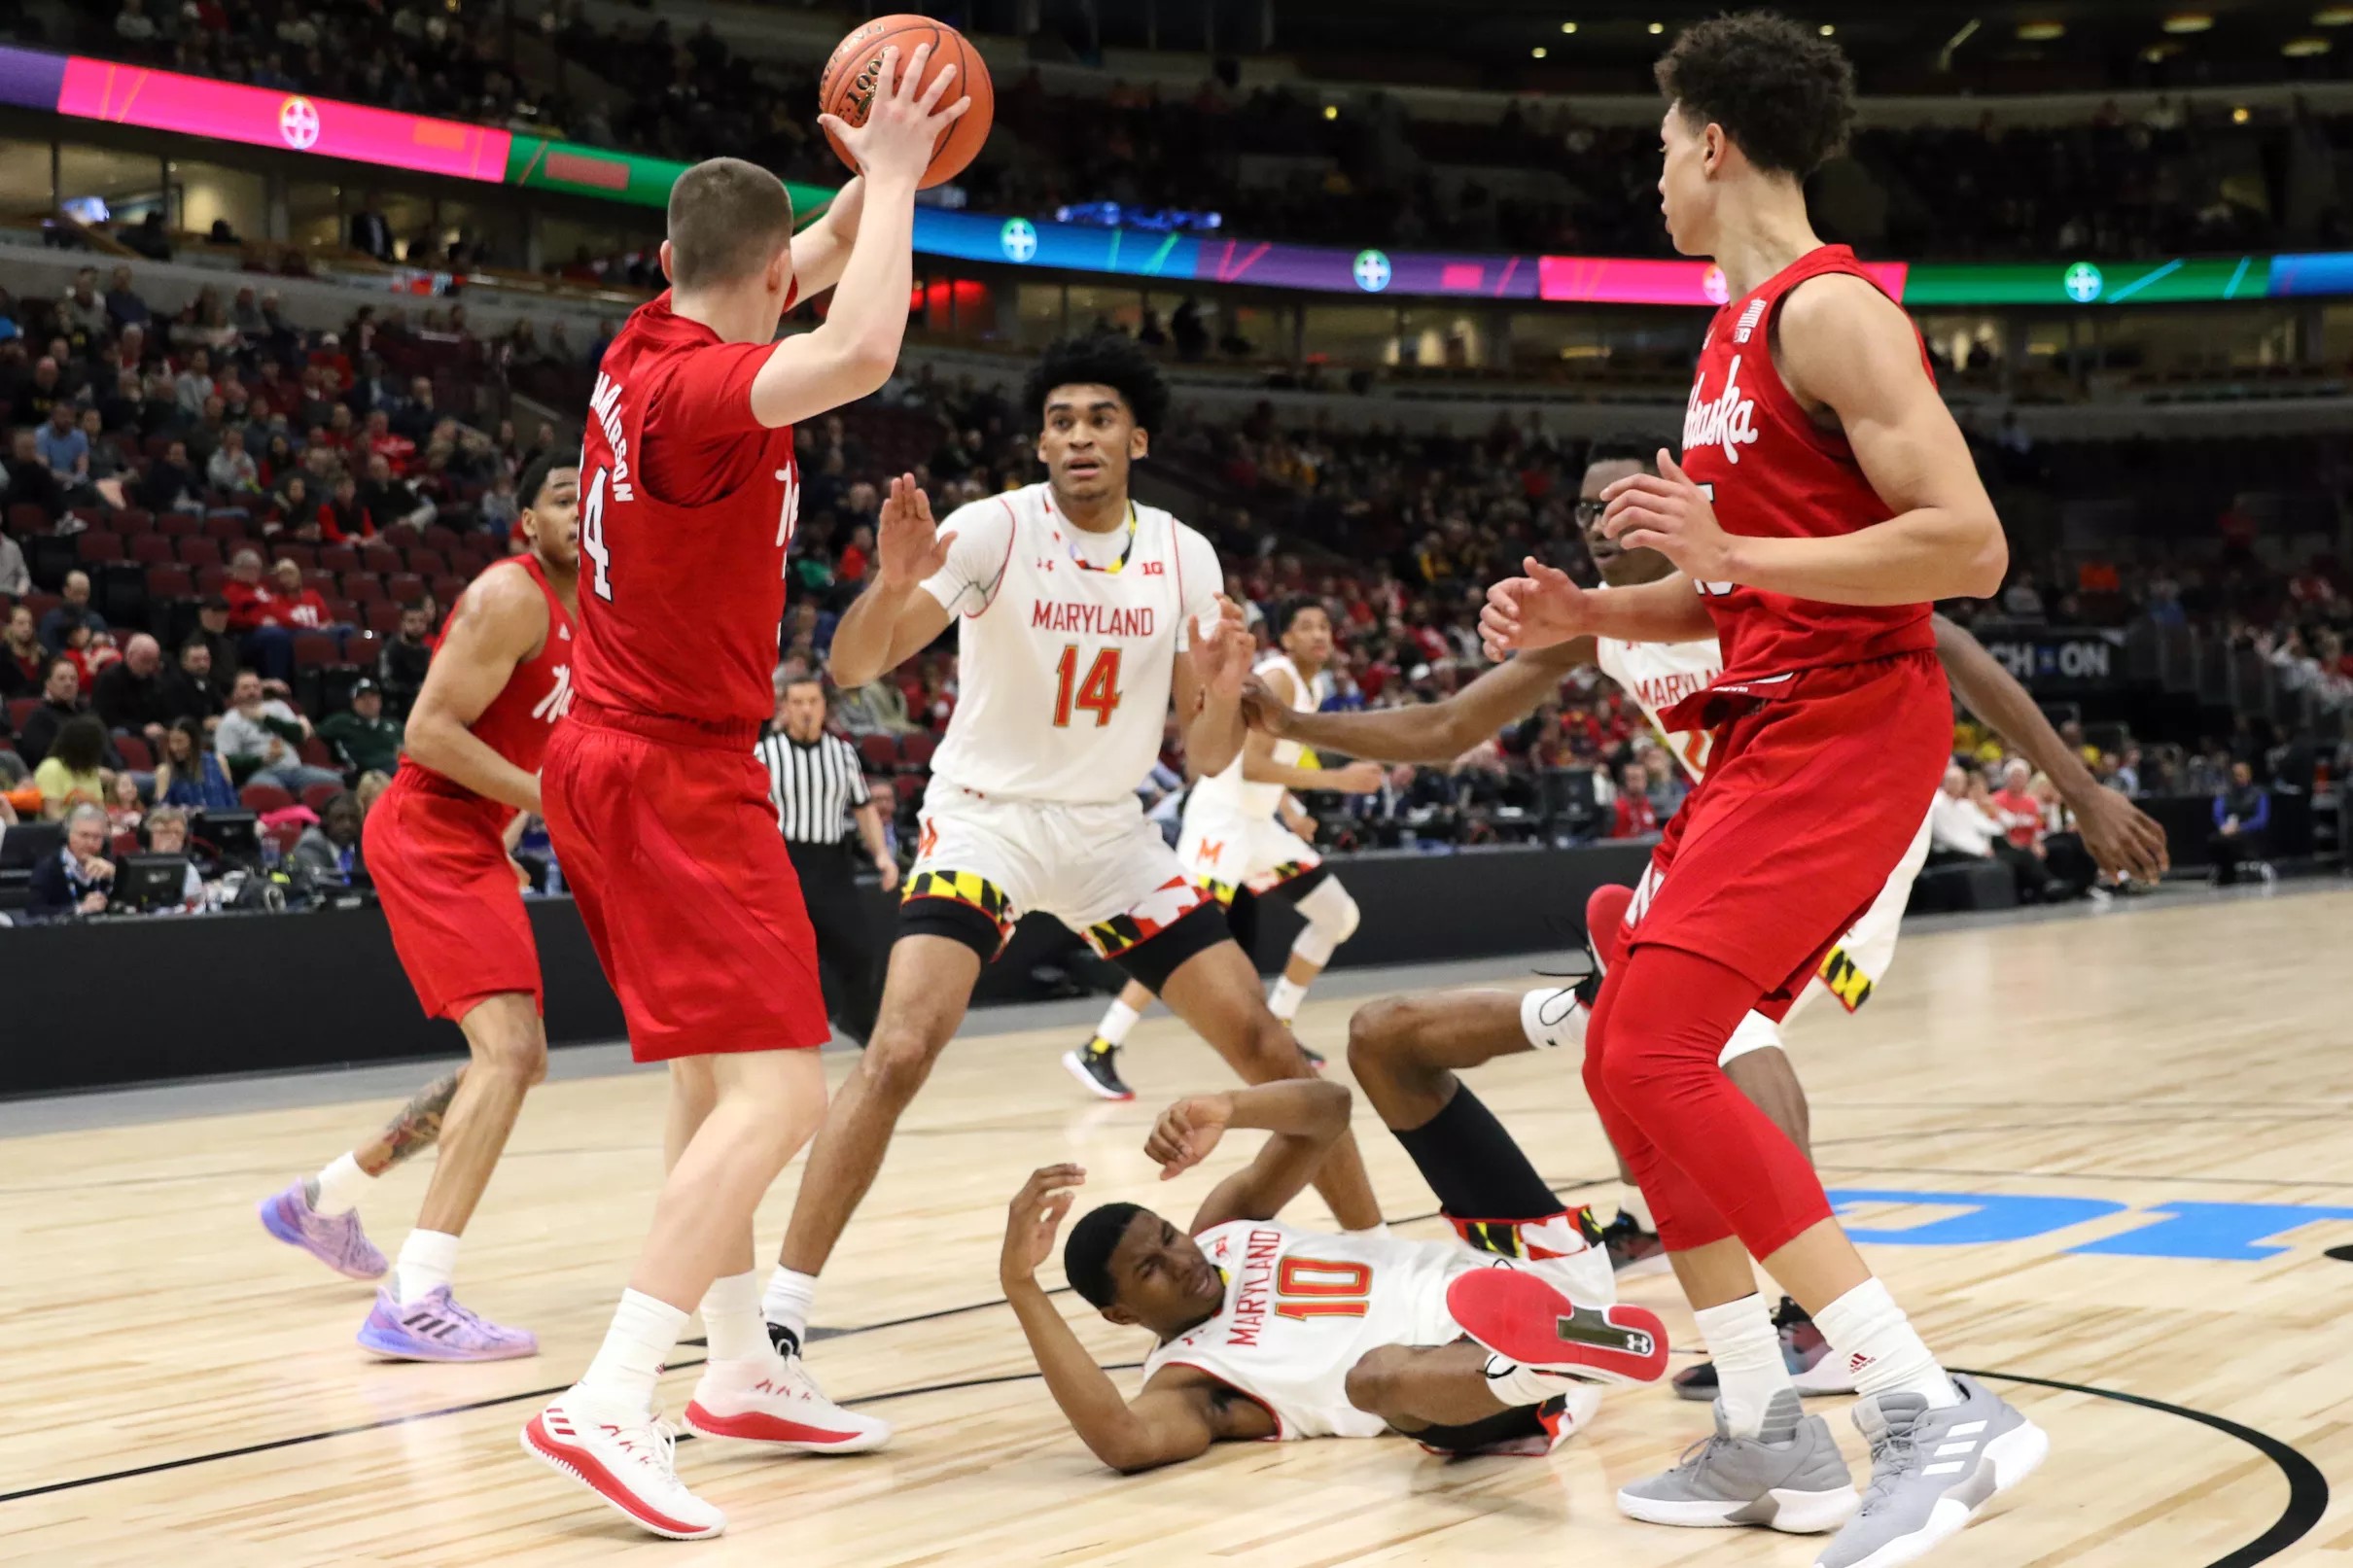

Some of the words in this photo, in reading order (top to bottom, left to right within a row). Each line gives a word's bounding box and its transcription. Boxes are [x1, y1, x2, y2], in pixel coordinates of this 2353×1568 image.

[1032, 599, 1155, 638] MARYLAND
[1053, 645, 1123, 727] 14
[2058, 642, 2111, 678] ON
[1197, 837, 1225, 867] M
[1226, 1230, 1282, 1346] MARYLAND
[1275, 1255, 1373, 1321] 10
